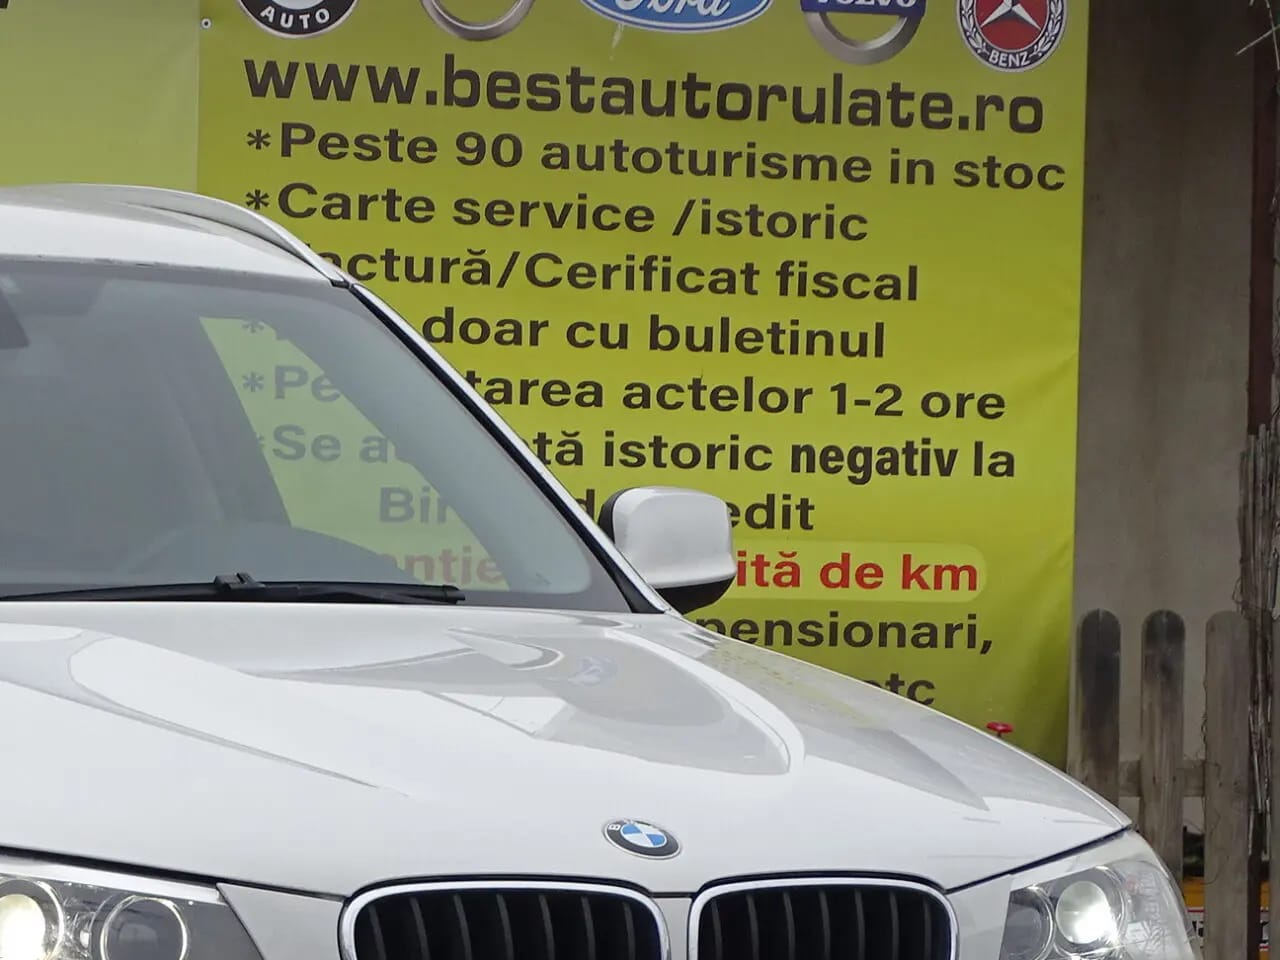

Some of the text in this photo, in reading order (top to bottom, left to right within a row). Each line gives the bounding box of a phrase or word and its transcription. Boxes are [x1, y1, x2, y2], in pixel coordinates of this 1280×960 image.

[259, 7, 331, 30] AUTO
[989, 49, 1031, 67] BENZ
[244, 53, 1046, 135] www.bestautorulate.ro
[455, 131, 523, 168] 90
[540, 139, 872, 183] autoturisme
[890, 147, 935, 186] in
[953, 155, 1065, 191] stoc
[452, 193, 655, 233] service
[775, 260, 918, 301] fiscal
[422, 306, 885, 358] doar cu buletinul
[622, 376, 813, 414] actelor
[830, 382, 904, 417] 1-2
[920, 391, 1005, 420] ore
[604, 430, 773, 472] istoric
[791, 437, 959, 486] negativ
[973, 440, 1015, 478] la
[819, 552, 883, 589] de
[901, 553, 976, 591] km
